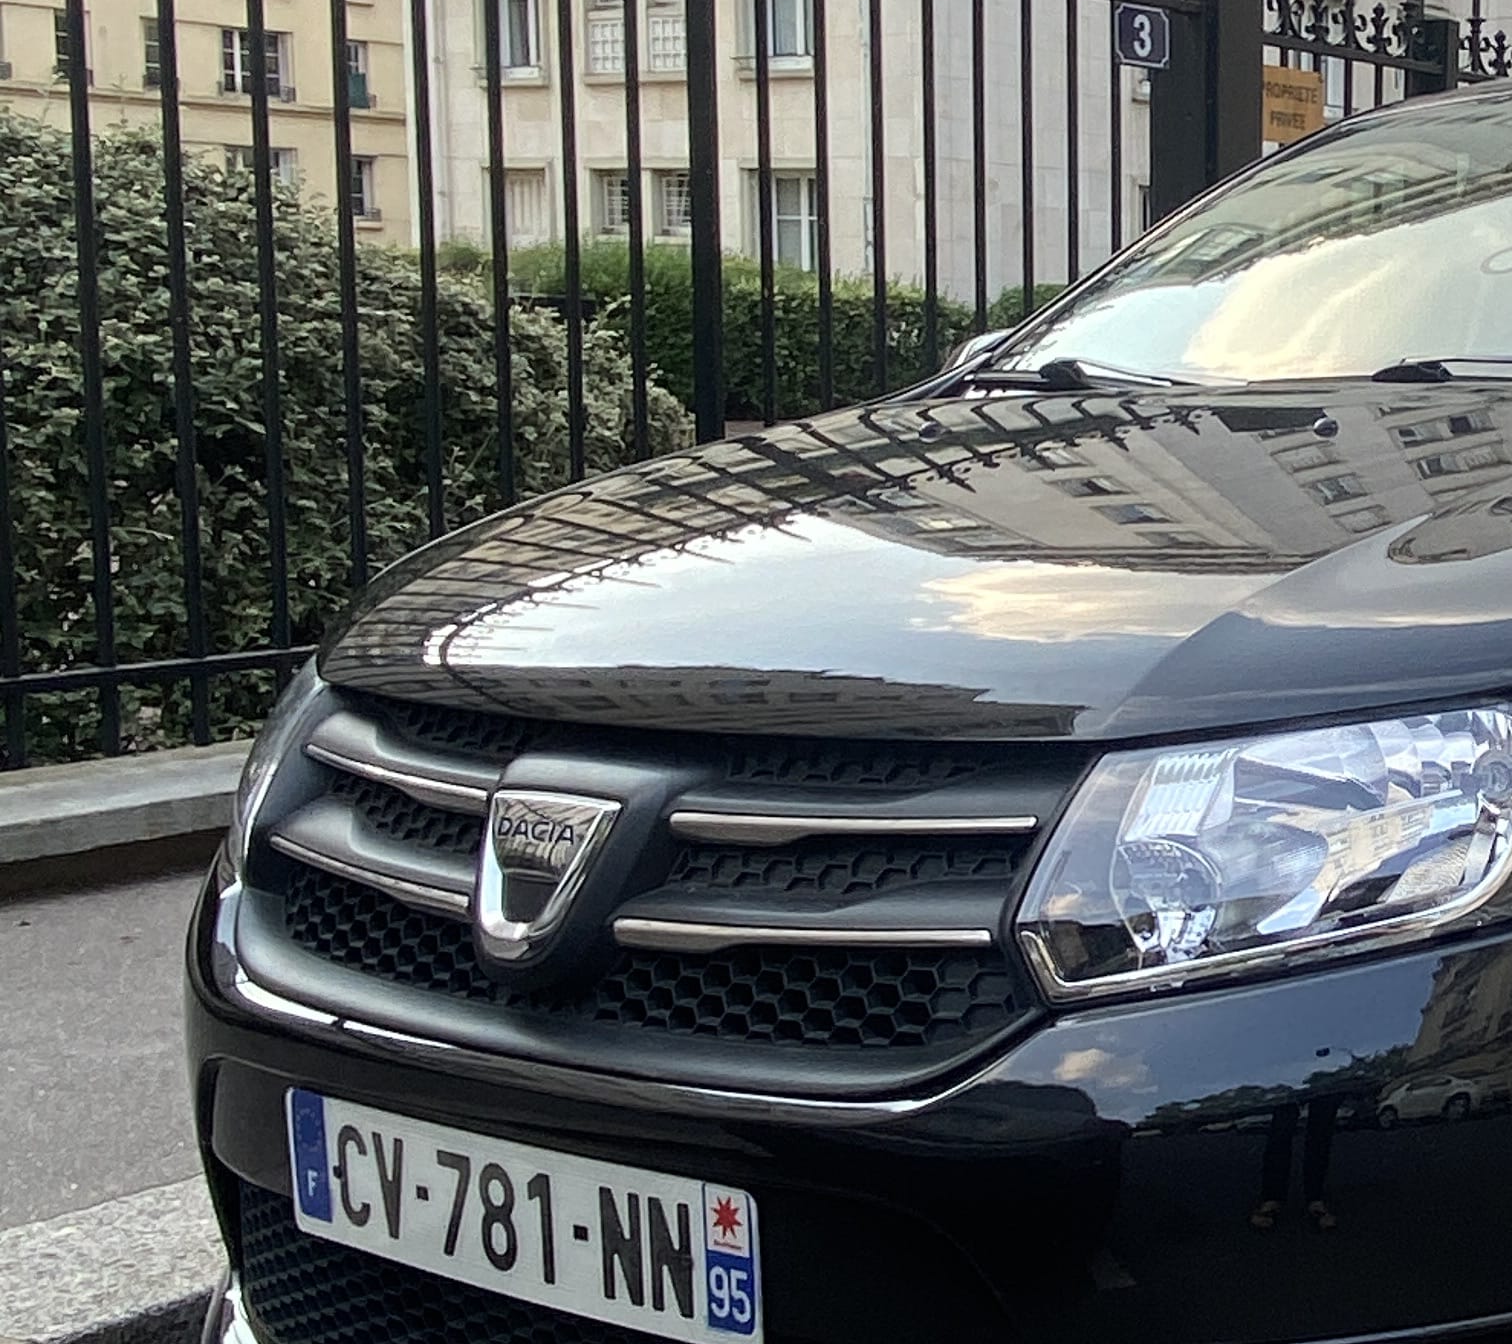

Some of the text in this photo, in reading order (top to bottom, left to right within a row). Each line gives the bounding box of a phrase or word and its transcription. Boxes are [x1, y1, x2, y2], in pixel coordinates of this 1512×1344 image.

[1133, 14, 1151, 57] 3
[1263, 81, 1318, 104] ROPRIETE
[498, 816, 575, 845] DACIA
[308, 1168, 319, 1197] F
[336, 1123, 695, 1320] CV-781-NN
[709, 1265, 752, 1324] 95
